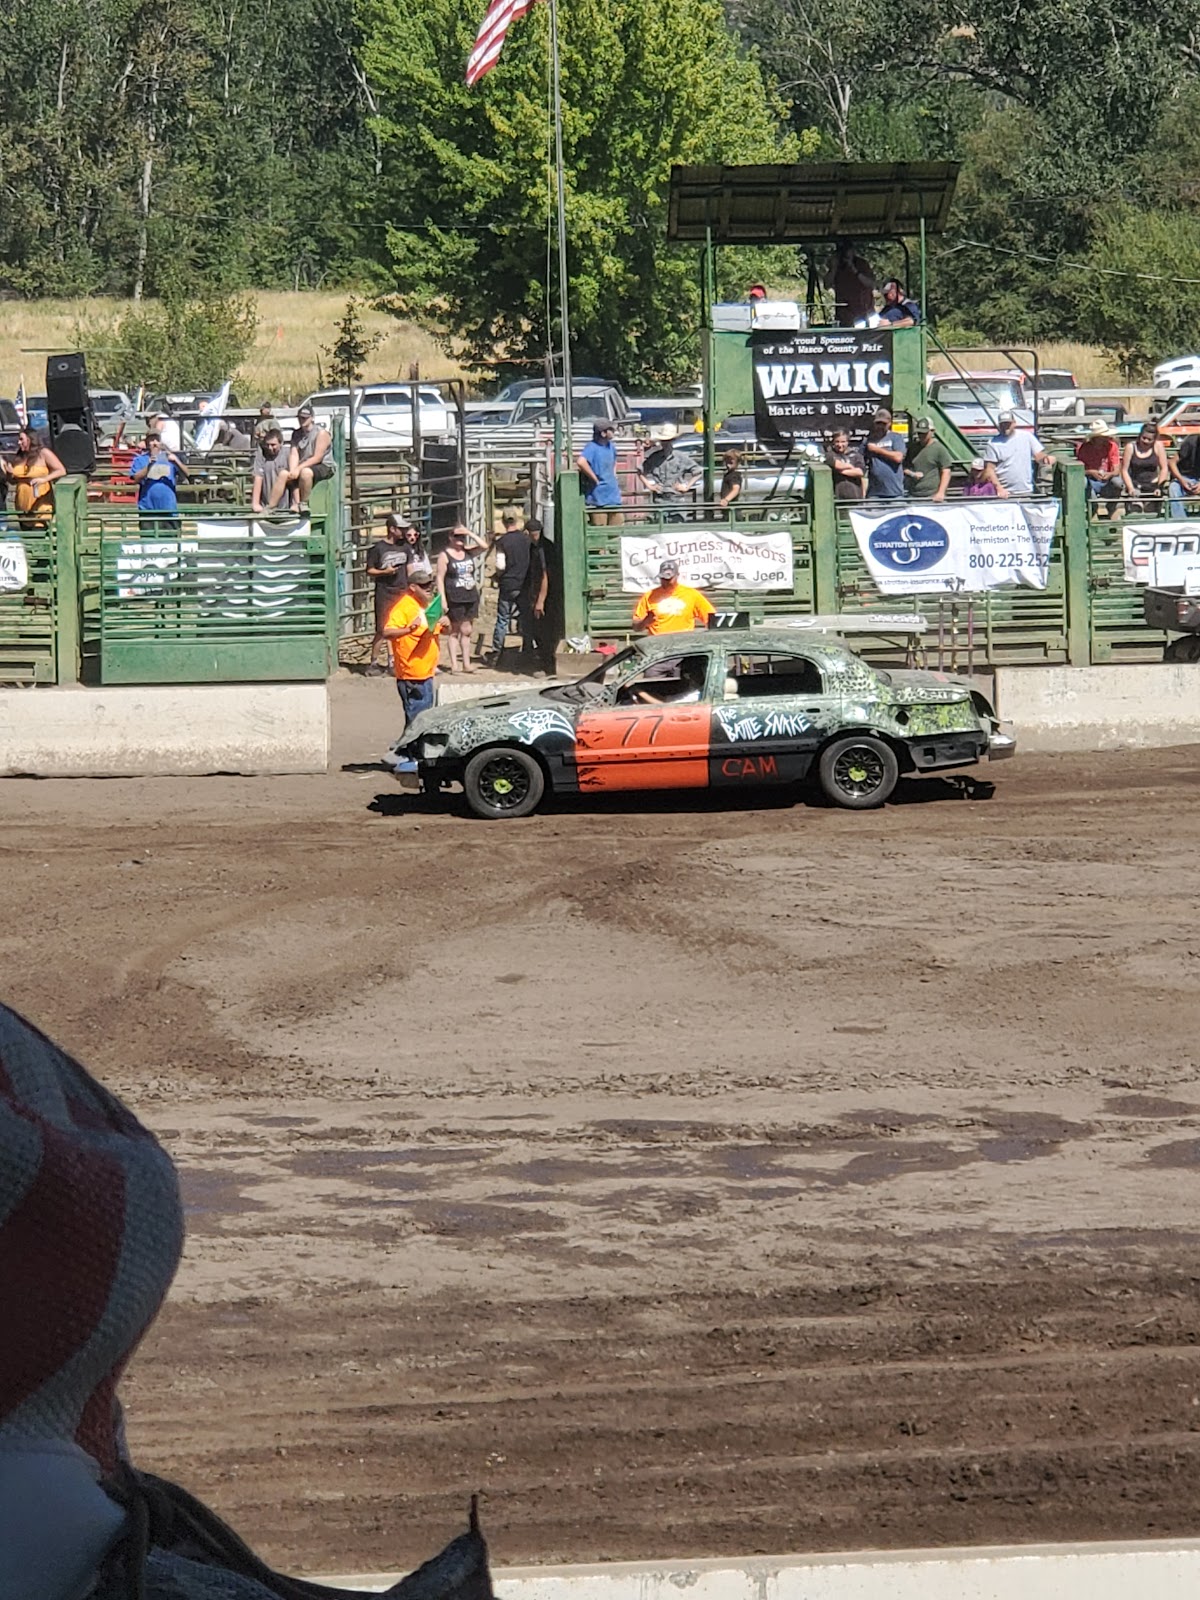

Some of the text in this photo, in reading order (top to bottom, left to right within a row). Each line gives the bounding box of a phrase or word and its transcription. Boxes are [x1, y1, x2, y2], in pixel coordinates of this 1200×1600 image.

[820, 336, 856, 346] Sponsor
[763, 346, 775, 355] of
[779, 345, 794, 354] the
[827, 344, 859, 354] County
[862, 343, 883, 352] Fair
[756, 361, 890, 399] WAMIC
[768, 403, 880, 416] Market & Supply
[970, 524, 1010, 533] Pendleton
[1017, 523, 1026, 532] La
[970, 535, 1010, 544] Hermiston
[1017, 535, 1031, 544] The
[666, 540, 724, 557] Urness
[728, 540, 787, 564] Motors
[690, 571, 746, 583] DODGE
[714, 612, 739, 627] 77
[615, 715, 664, 747] 77
[721, 710, 812, 743] BATTLE SNAKE
[721, 755, 779, 779] CAM
